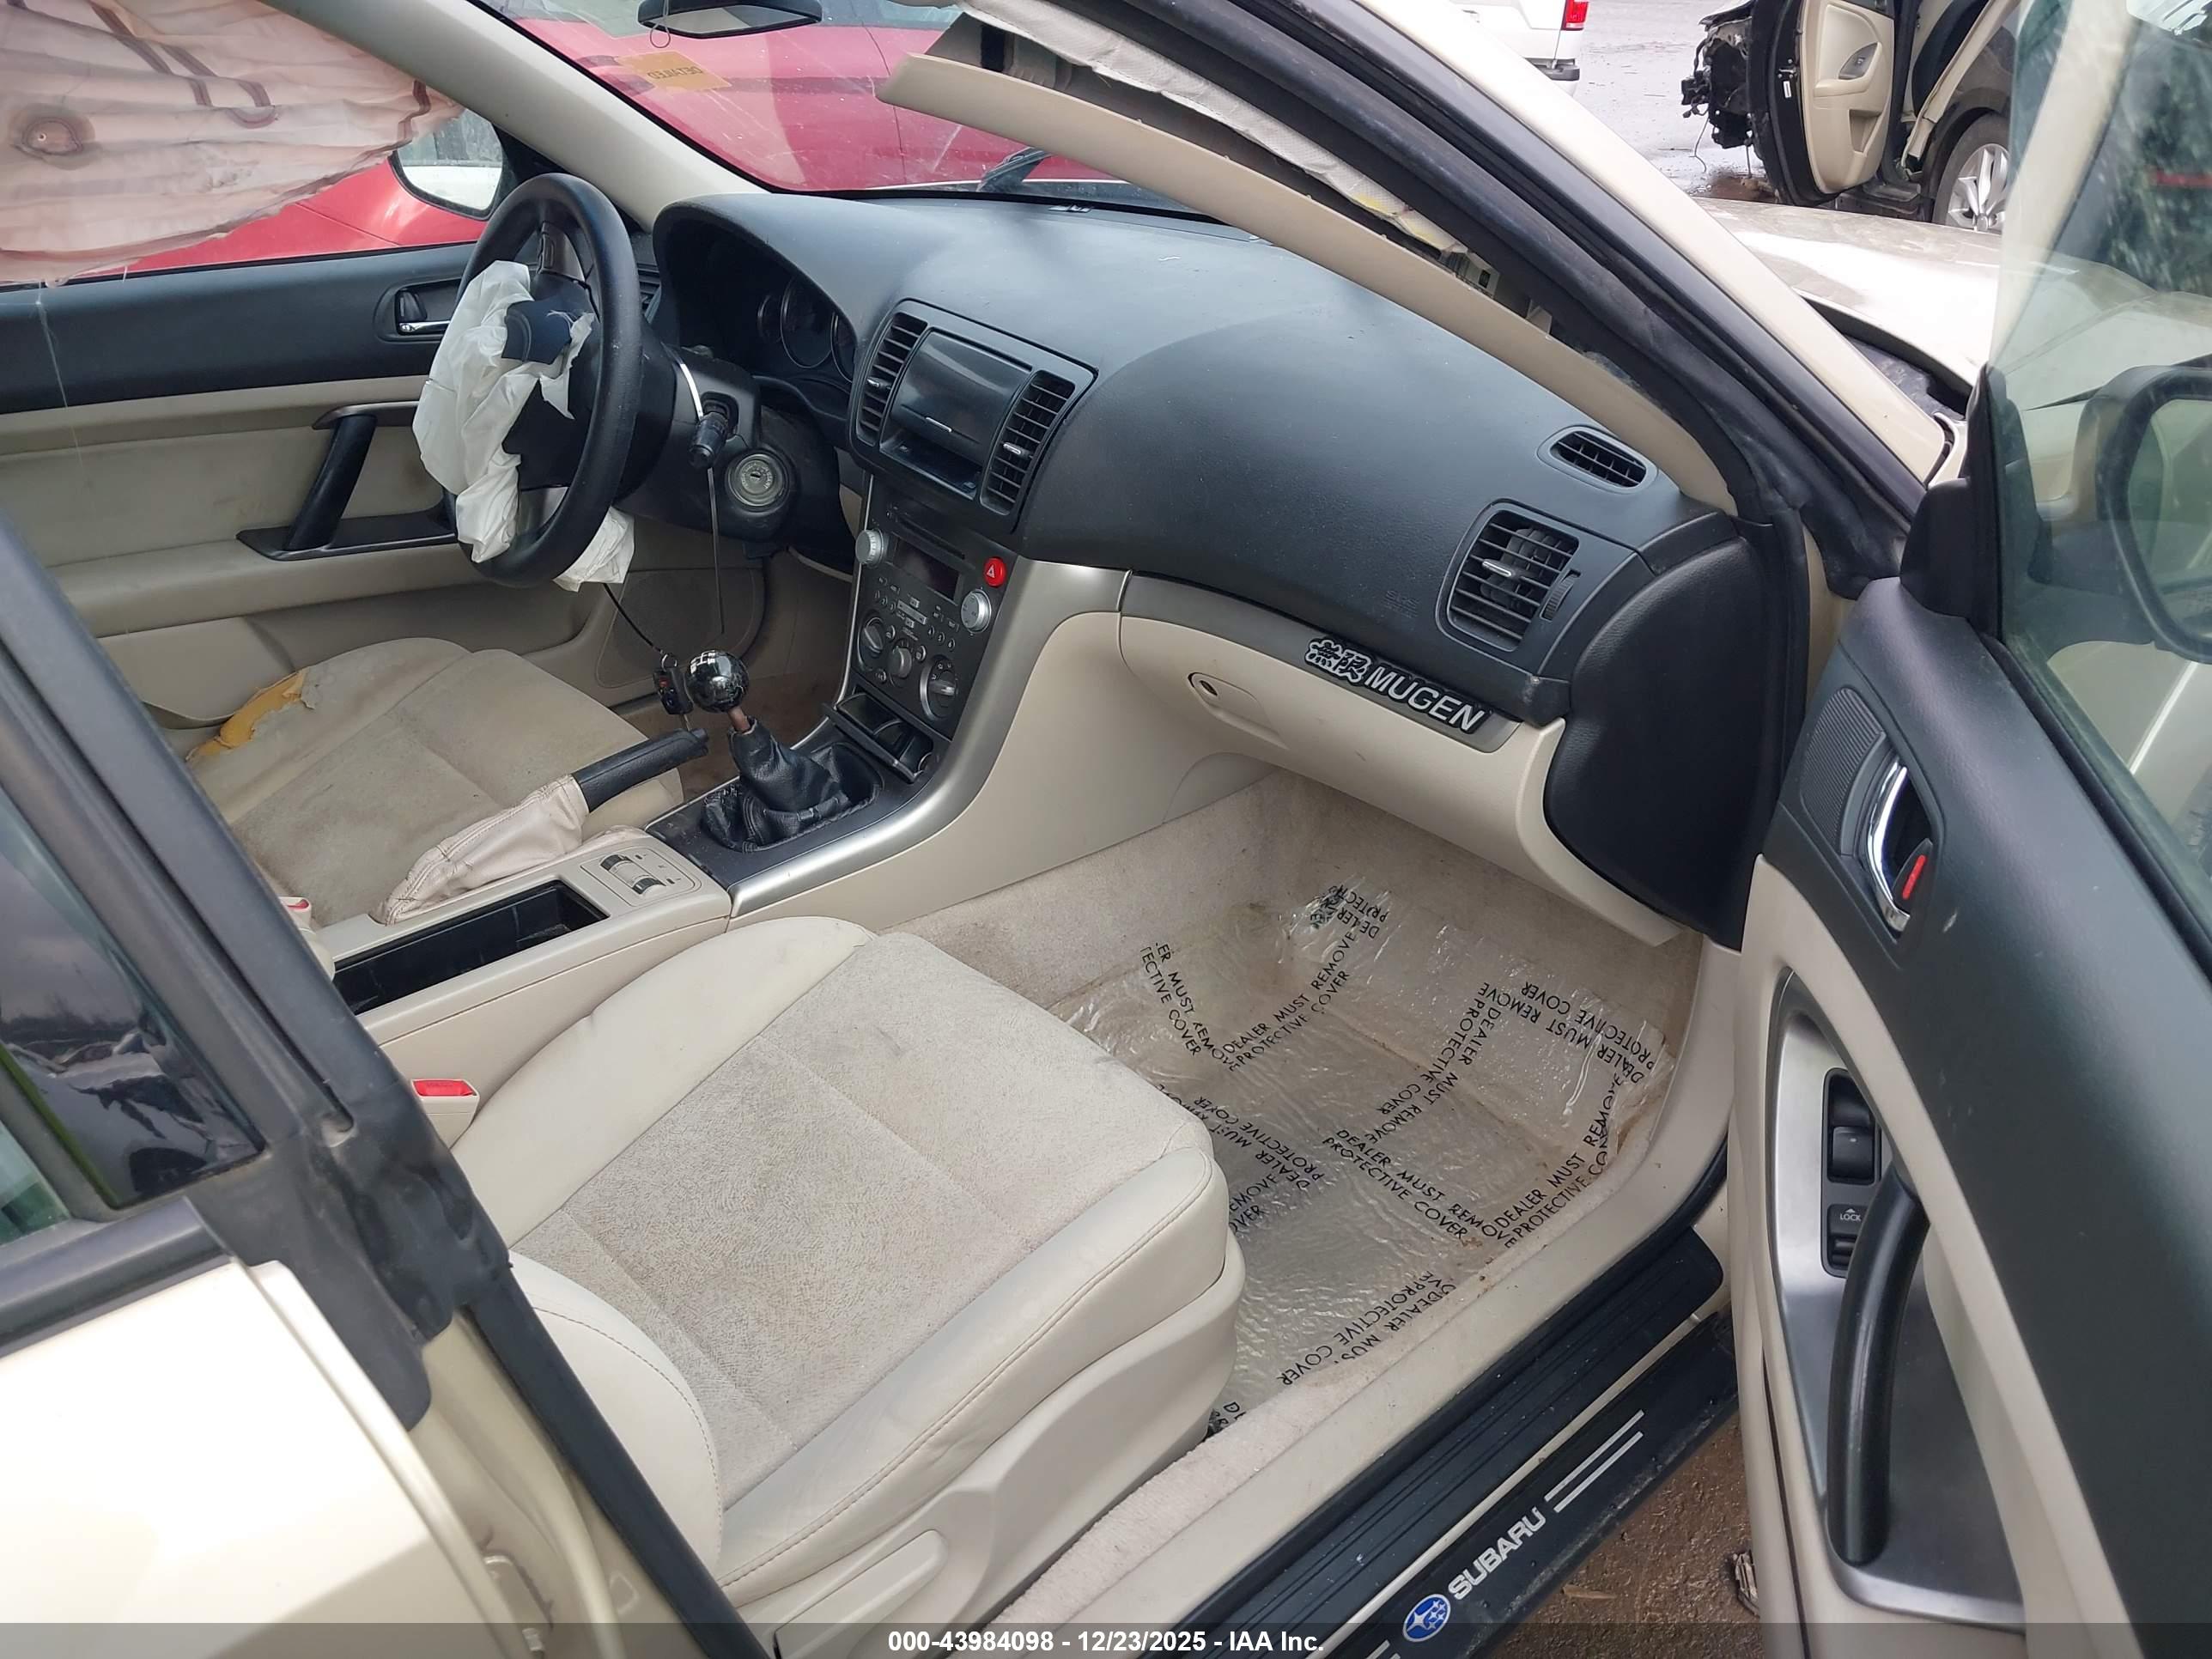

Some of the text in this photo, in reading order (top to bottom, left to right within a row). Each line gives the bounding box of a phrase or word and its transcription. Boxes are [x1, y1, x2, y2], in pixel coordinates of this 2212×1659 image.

[1364, 665, 1486, 731] MUGEN
[1168, 971, 1195, 1015] MUST
[1223, 931, 1357, 1054] DEALER MUST REMOVE
[1237, 969, 1350, 1067] PROTECTIVE COVER
[1521, 981, 1571, 1015] COVER
[1169, 1009, 1202, 1056] COVER
[1376, 998, 1485, 1115] PROTECTIVE COVER
[1478, 982, 1644, 1084] DEALER MUST REMOVE
[1194, 1096, 1239, 1125] COVER
[1364, 1007, 1501, 1144] DEALER MUST REMOVE
[1239, 1121, 1326, 1182] PROTECTIVE
[1255, 1149, 1311, 1189] DEALER
[1322, 1137, 1470, 1240] PROTECTIVE COVER
[1336, 1129, 1518, 1249] DEALER MUST REMOVE
[1494, 1188, 1547, 1229] DEALER
[1547, 1152, 1586, 1188] MUST
[1512, 1176, 1589, 1238] PROTECTIVE
[1840, 1213, 1861, 1222] LOCK
[1276, 1281, 1425, 1385] PROTECTIVE COVER
[1384, 1291, 1442, 1332] DEALER
[1448, 1506, 1546, 1600] SUBARU
